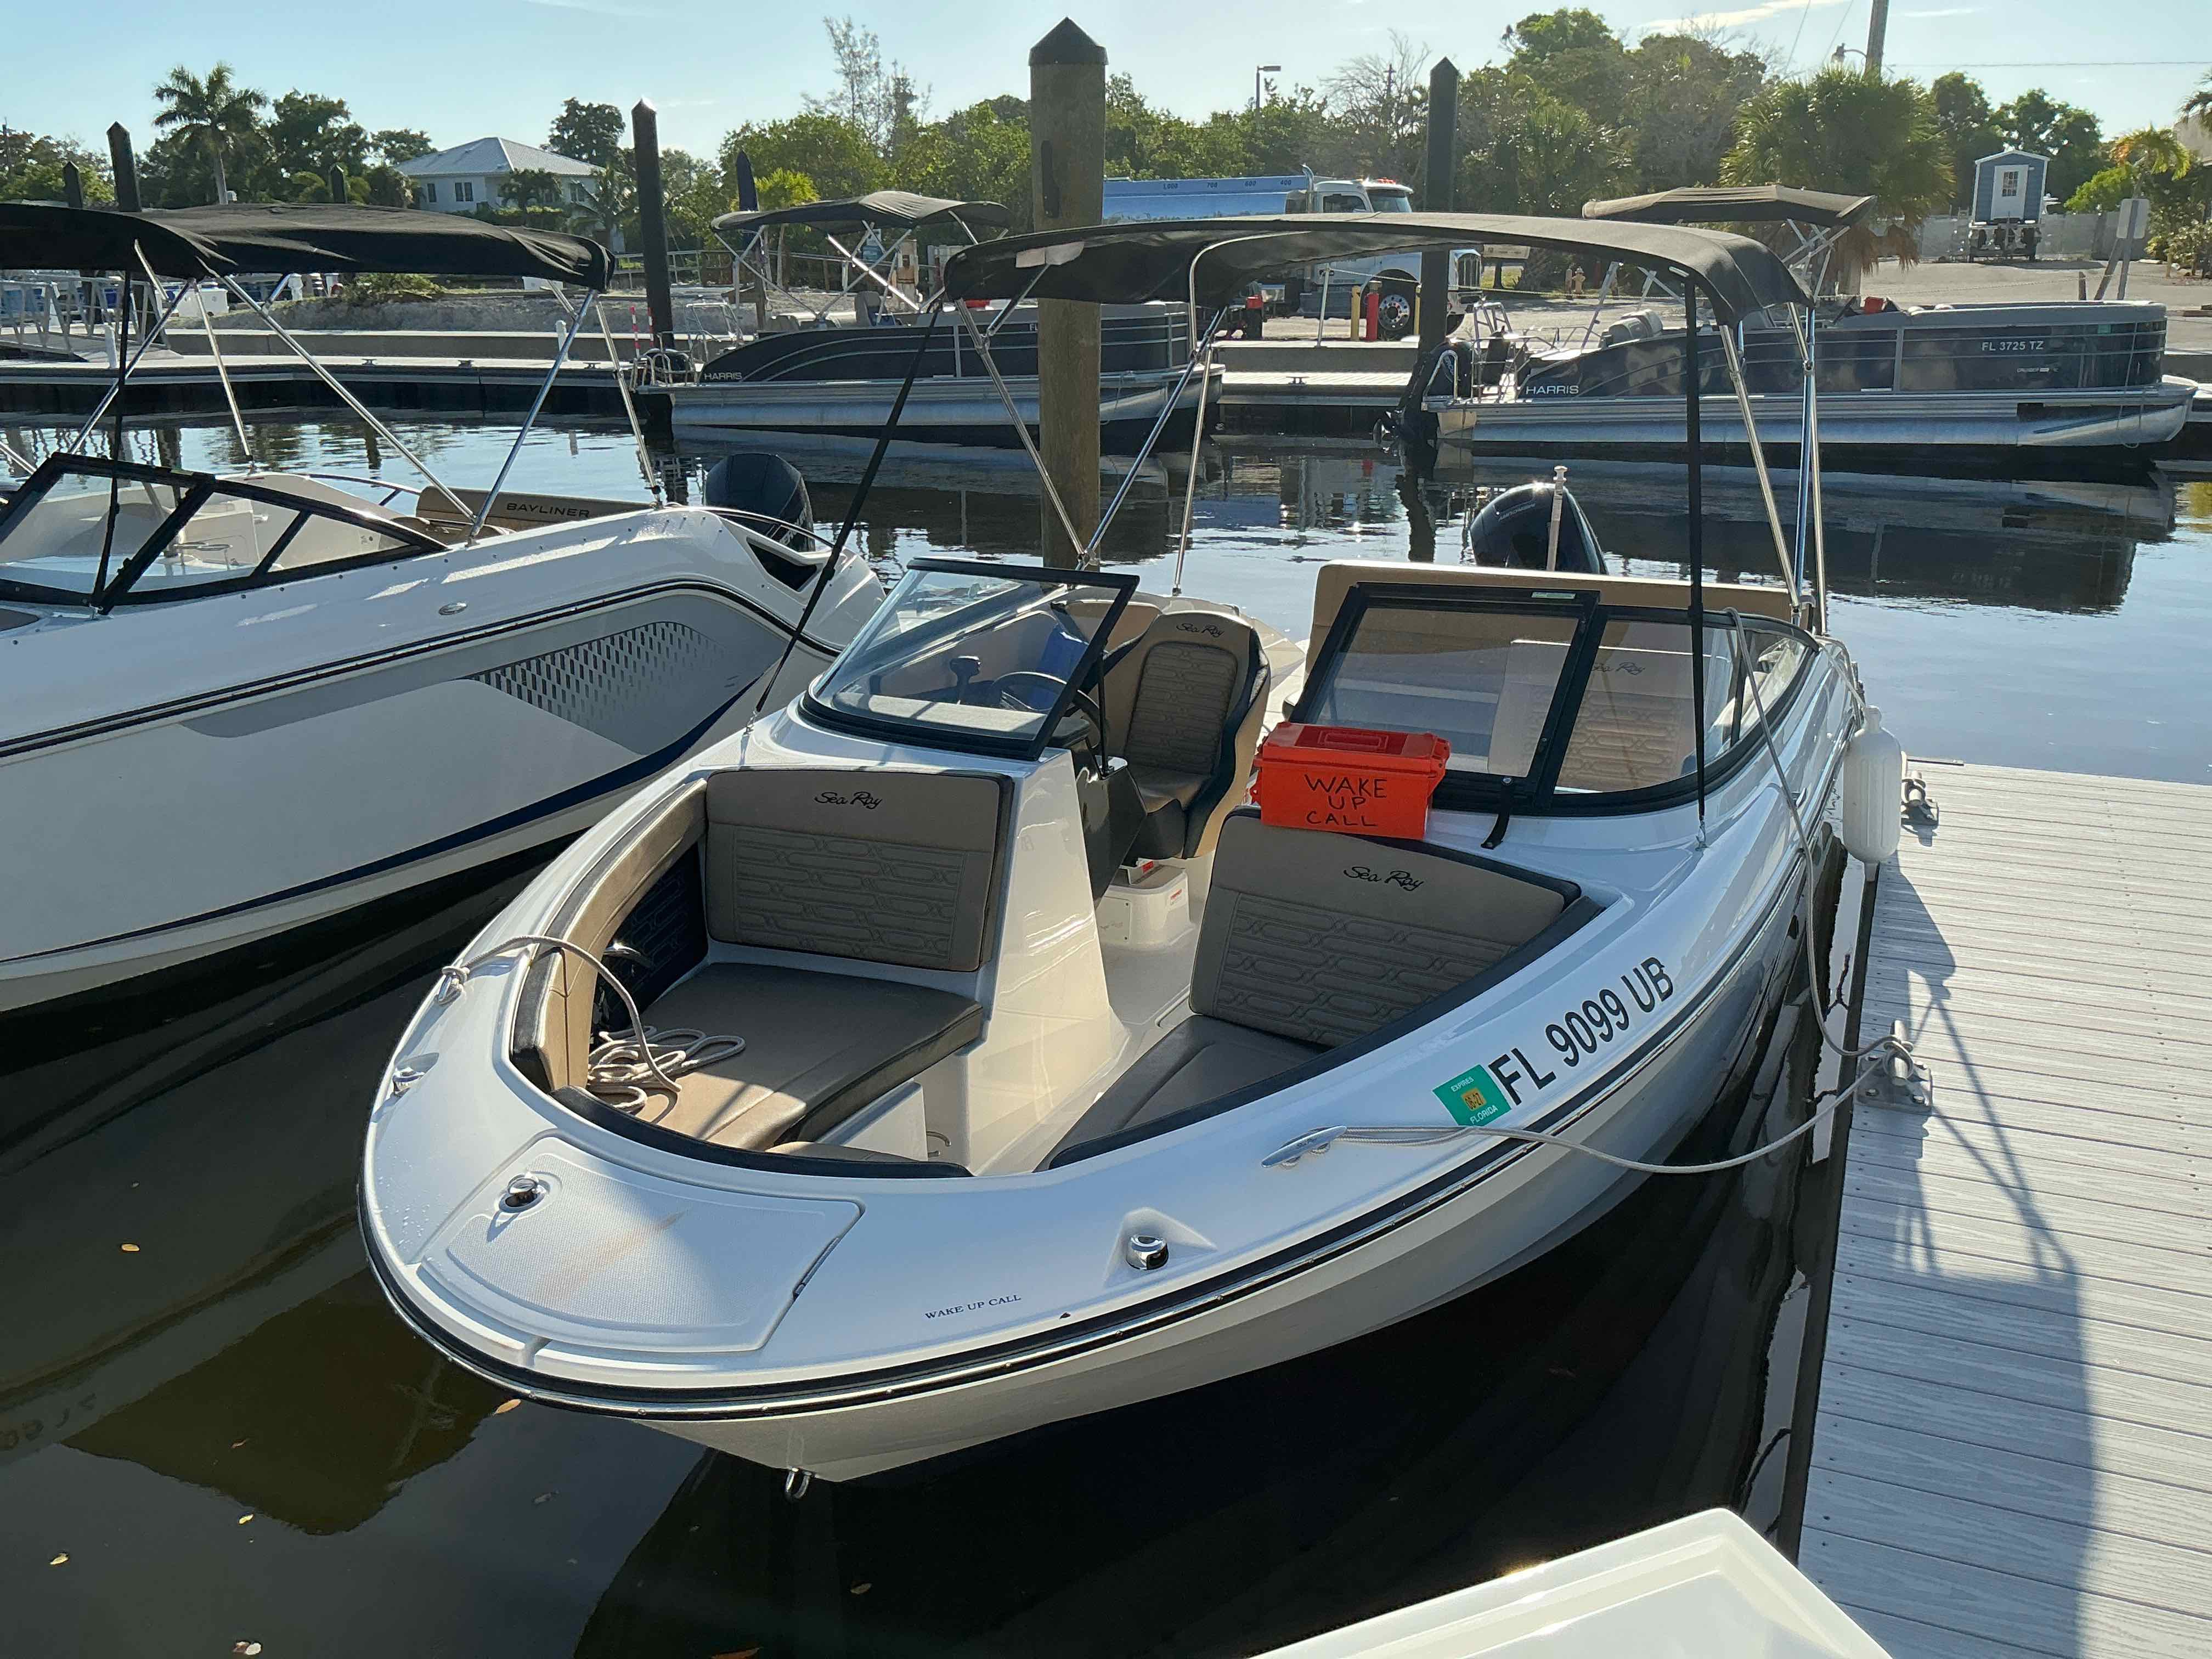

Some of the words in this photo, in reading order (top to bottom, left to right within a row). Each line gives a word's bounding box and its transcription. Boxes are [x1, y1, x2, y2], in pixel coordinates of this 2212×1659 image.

[1982, 342, 1996, 351] FL
[1999, 341, 2025, 351] 3725
[2029, 341, 2044, 349] TZ
[704, 372, 742, 380] HARRIS
[1526, 385, 1579, 395] HARRIS
[506, 503, 590, 518] BAYLINER
[1176, 623, 1199, 632] Sea
[1201, 625, 1224, 637] Ray
[1616, 662, 1645, 675] Ray
[1304, 774, 1387, 798] WAKE
[814, 792, 848, 804] Sea
[850, 791, 882, 809] Ray
[1328, 795, 1366, 810] UP
[1306, 811, 1379, 826] CALL
[1344, 866, 1382, 882] Sea
[1384, 870, 1425, 891] Ray
[1488, 1047, 1557, 1106] FL
[1545, 989, 1630, 1067] 9099
[1621, 957, 1673, 1013] UB
[1451, 1076, 1475, 1092] EXPIRES
[1470, 1104, 1499, 1124] FLORIDA
[924, 1306, 964, 1319] WAKE
[967, 1301, 985, 1311] UP
[989, 1295, 1022, 1306] CALL
